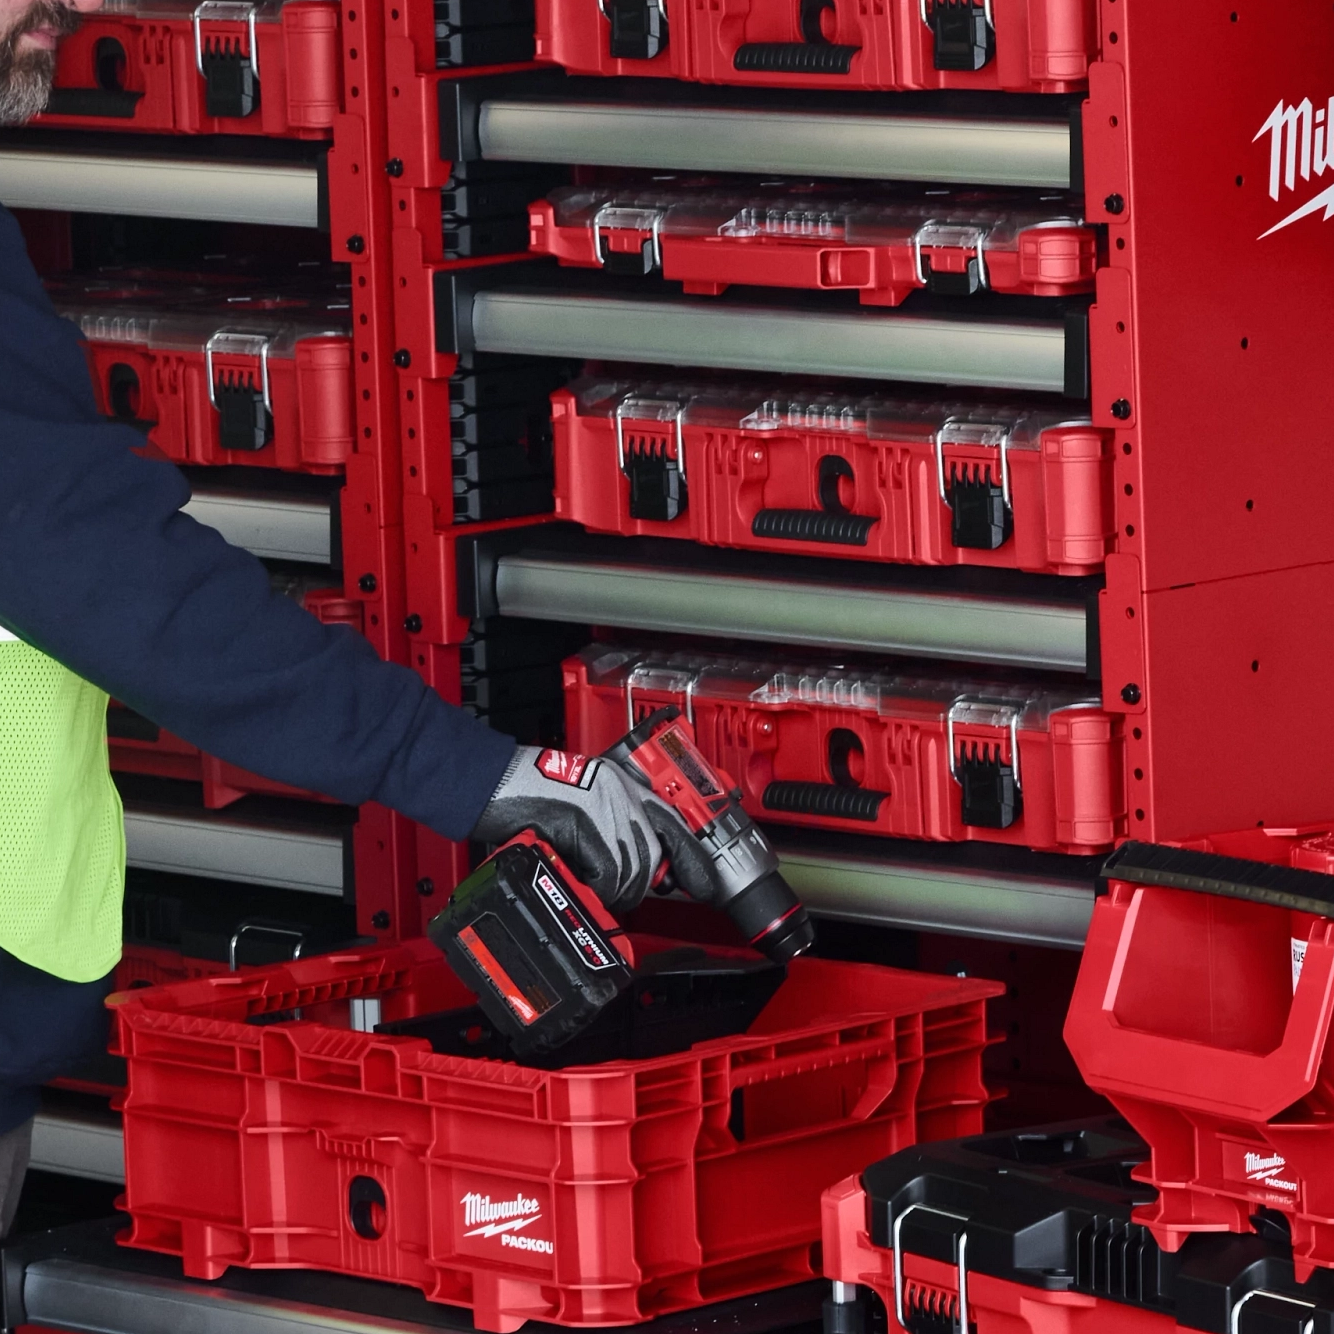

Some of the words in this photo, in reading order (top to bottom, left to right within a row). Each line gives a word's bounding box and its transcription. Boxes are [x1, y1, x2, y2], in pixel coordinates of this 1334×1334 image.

[541, 878, 565, 906] M18
[1243, 1152, 1286, 1173] Milwaukee
[1264, 1177, 1298, 1192] PACKOUT
[459, 1191, 541, 1227] Milwaukee
